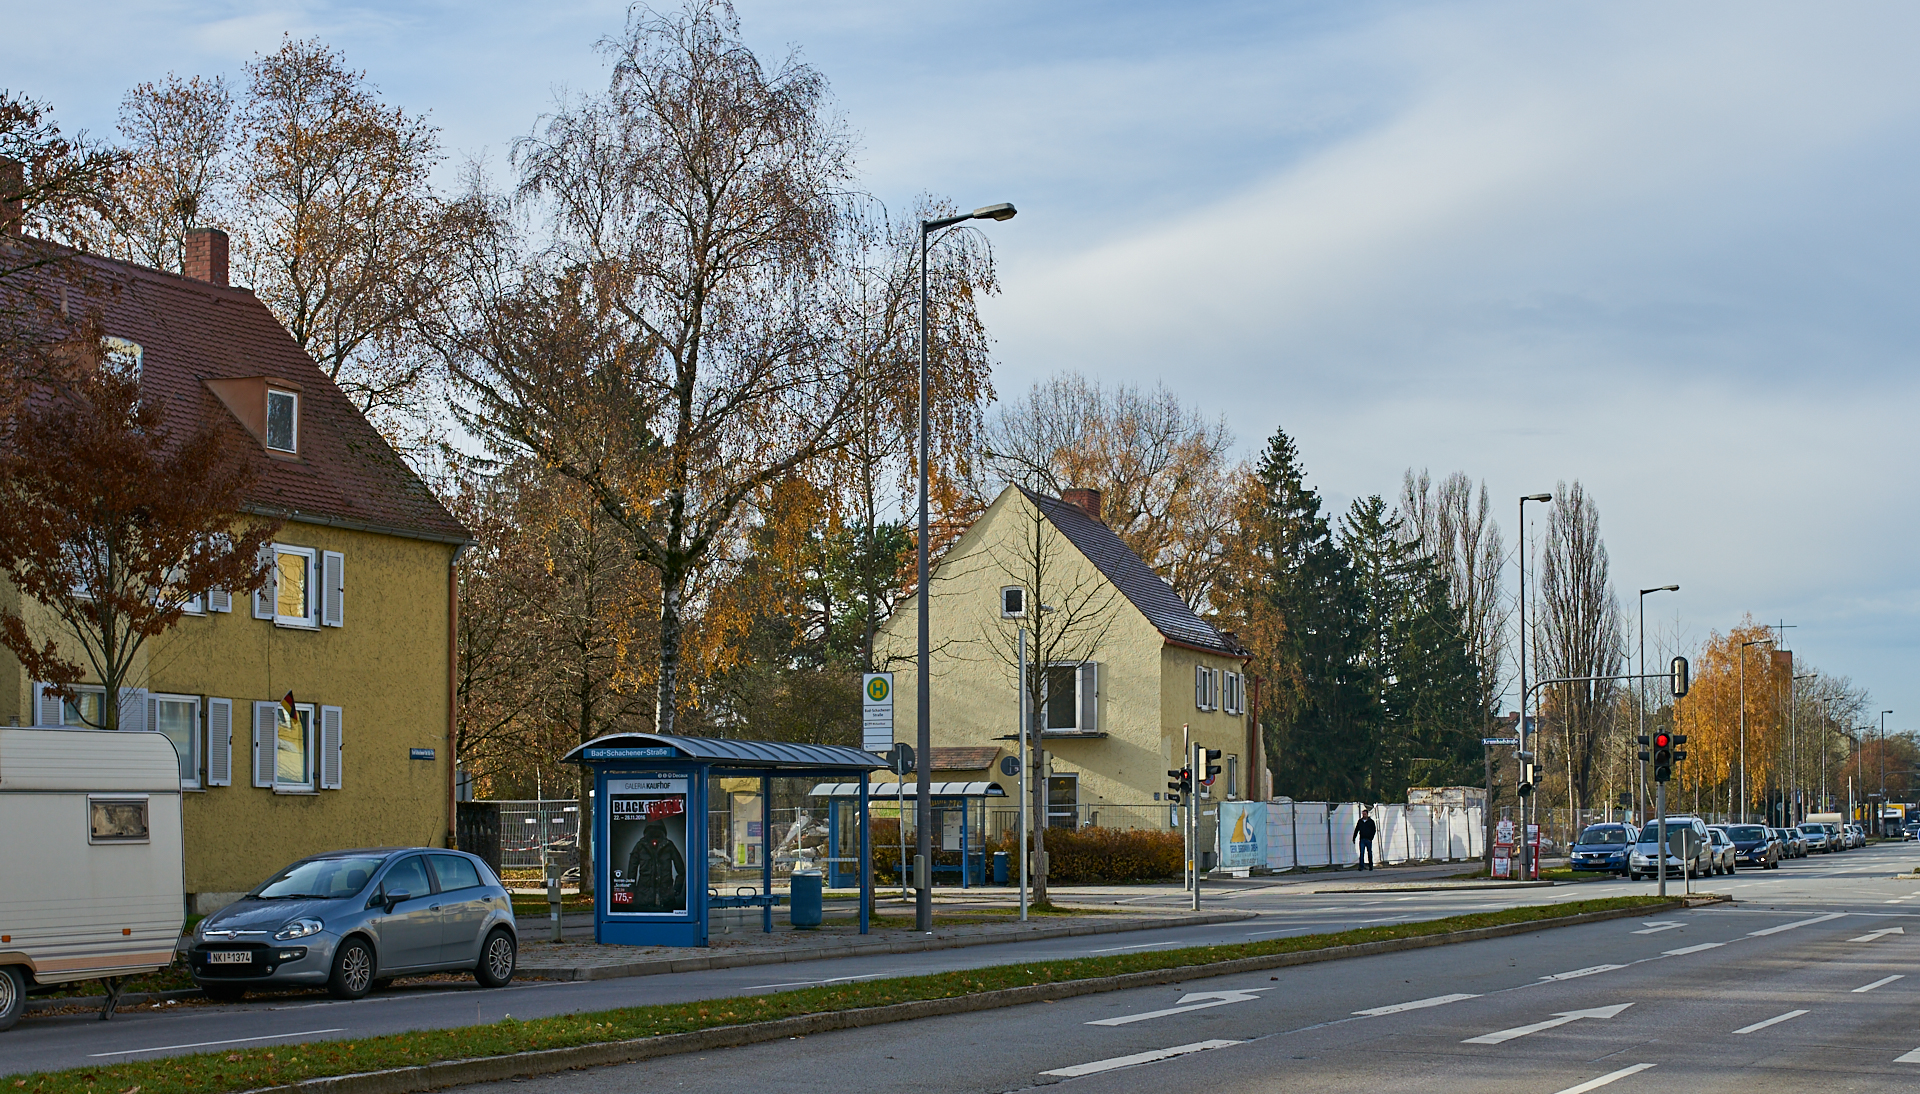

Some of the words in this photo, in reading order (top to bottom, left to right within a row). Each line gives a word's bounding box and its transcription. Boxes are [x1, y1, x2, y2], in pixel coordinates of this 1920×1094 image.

[873, 683, 883, 696] H
[591, 748, 667, 757] Bad-Schachener-Straße
[625, 782, 646, 790] GALERIA
[614, 801, 645, 813] BLACK
[614, 892, 632, 903] 175,-
